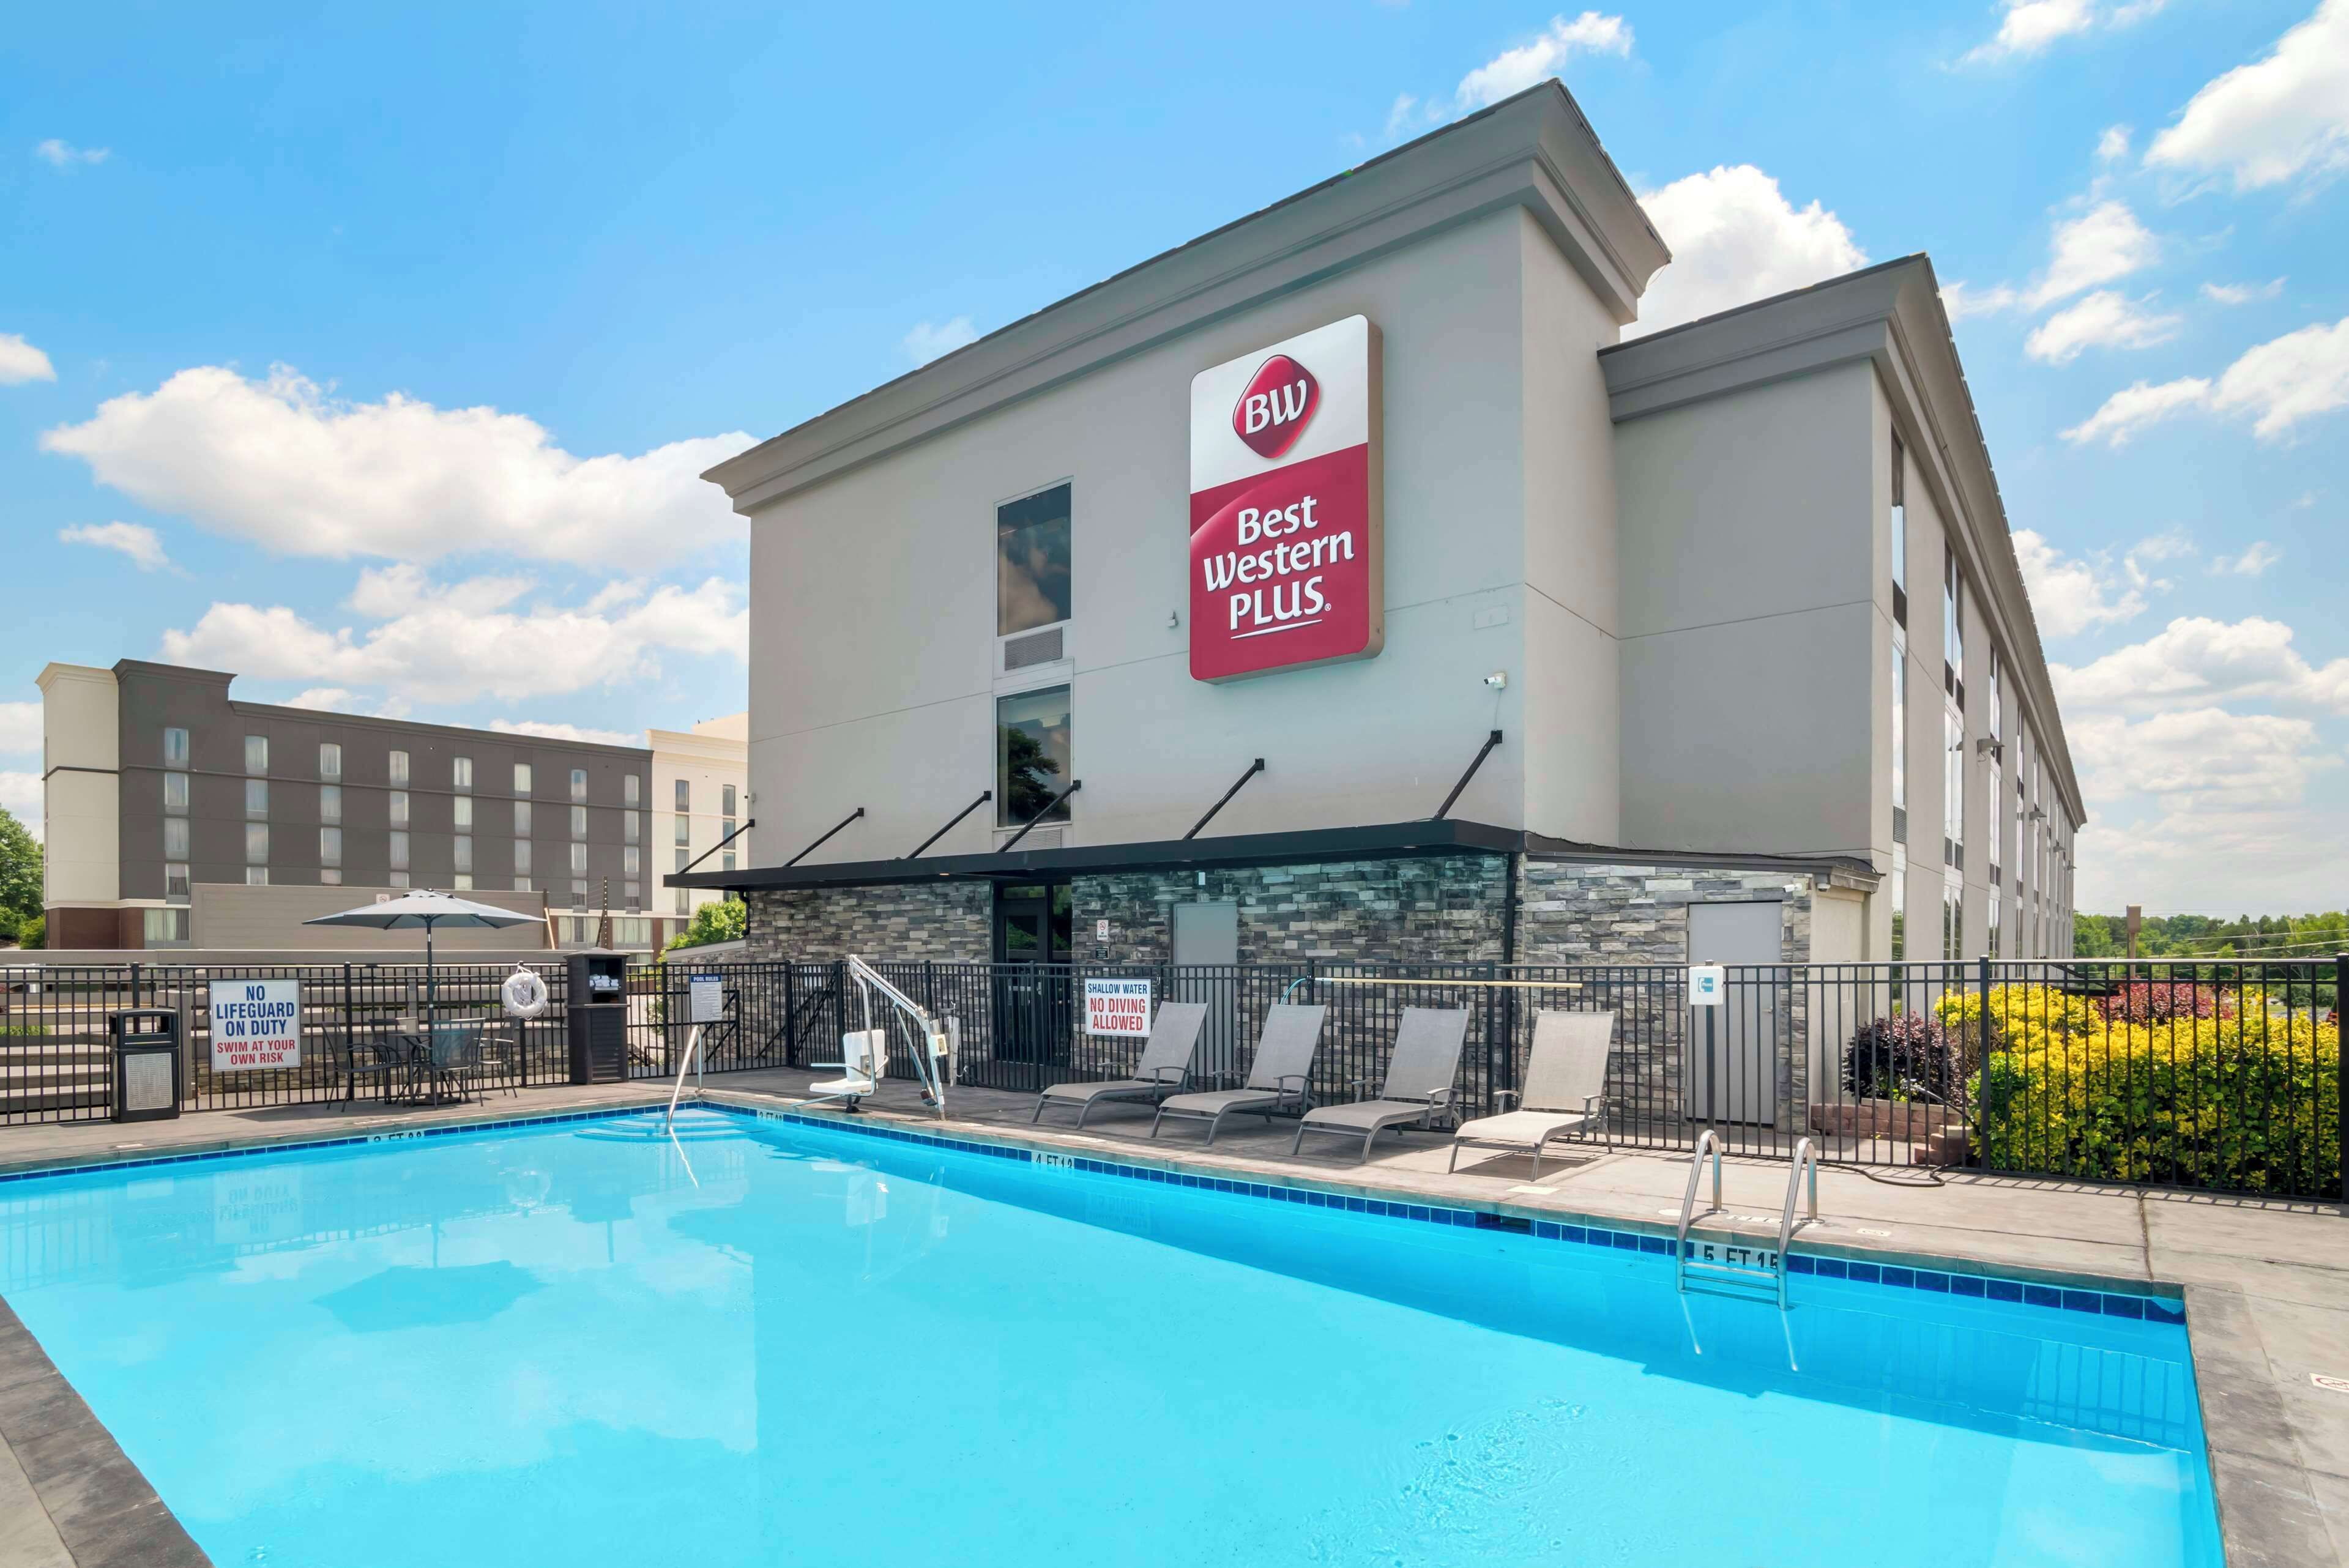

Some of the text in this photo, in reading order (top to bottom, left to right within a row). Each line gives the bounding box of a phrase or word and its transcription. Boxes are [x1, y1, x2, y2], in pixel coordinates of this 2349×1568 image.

[1246, 379, 1307, 434] BW
[1238, 495, 1318, 546] Best
[1204, 530, 1354, 592] Western
[246, 985, 265, 1001] NO
[1088, 983, 1147, 994] SHALLOW WATER
[216, 1002, 294, 1019] LIFEGUARD
[1090, 998, 1145, 1014] NO DIVING
[225, 1019, 286, 1036] ON DUTY
[1093, 1014, 1143, 1031] ALLOWED
[217, 1039, 295, 1053] SWIM AT YOUR
[231, 1052, 283, 1065] OWN RISK
[1047, 1155, 1059, 1167] FT
[1704, 1245, 1714, 1261] 5
[1726, 1247, 1751, 1265] FT
